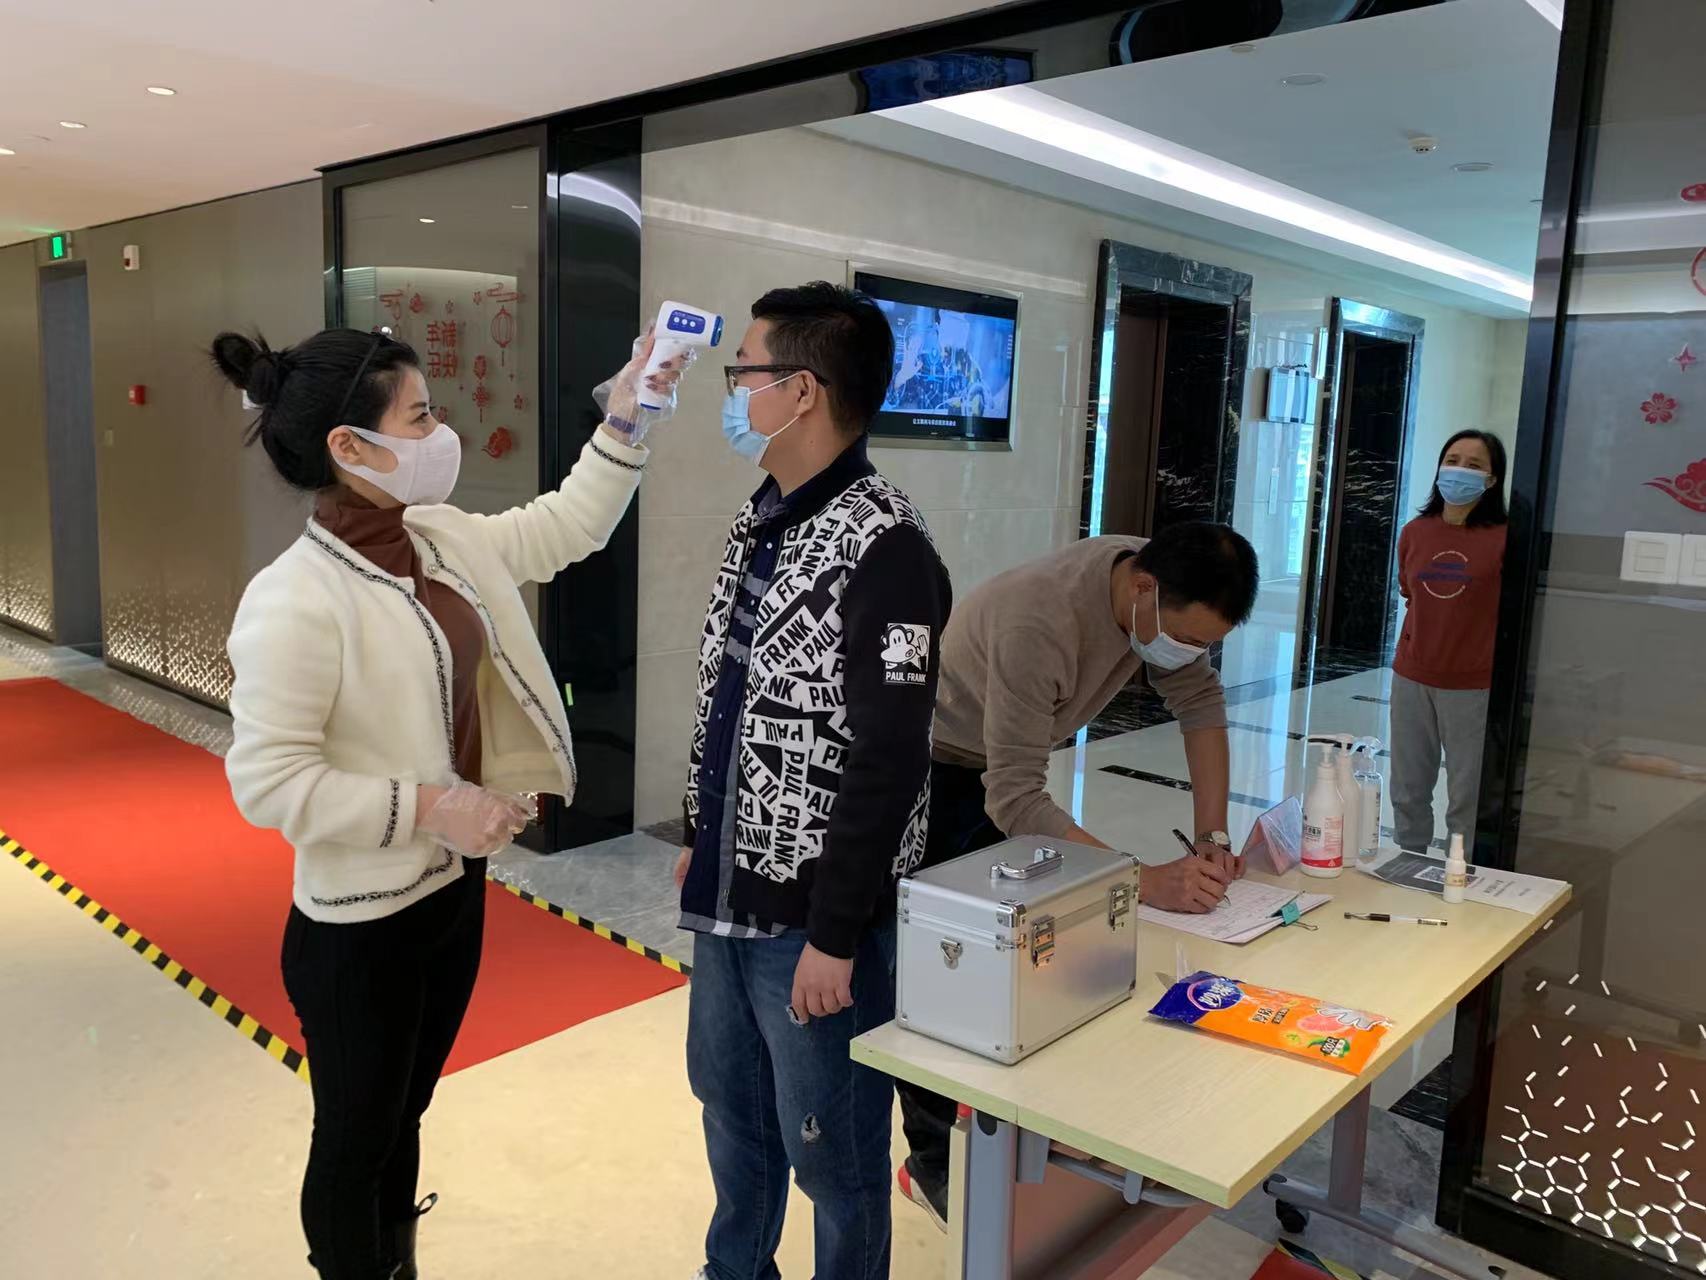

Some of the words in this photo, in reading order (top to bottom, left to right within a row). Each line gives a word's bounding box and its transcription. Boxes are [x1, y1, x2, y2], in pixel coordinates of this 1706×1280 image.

[796, 517, 840, 582] FRANK
[760, 613, 813, 673] FRANK
[802, 620, 842, 666] PAUL
[886, 671, 905, 681] PAUL
[907, 672, 926, 683] FRANK
[761, 719, 803, 742] PAUL
[781, 749, 806, 796] PAUL
[774, 803, 800, 871] FRANK
